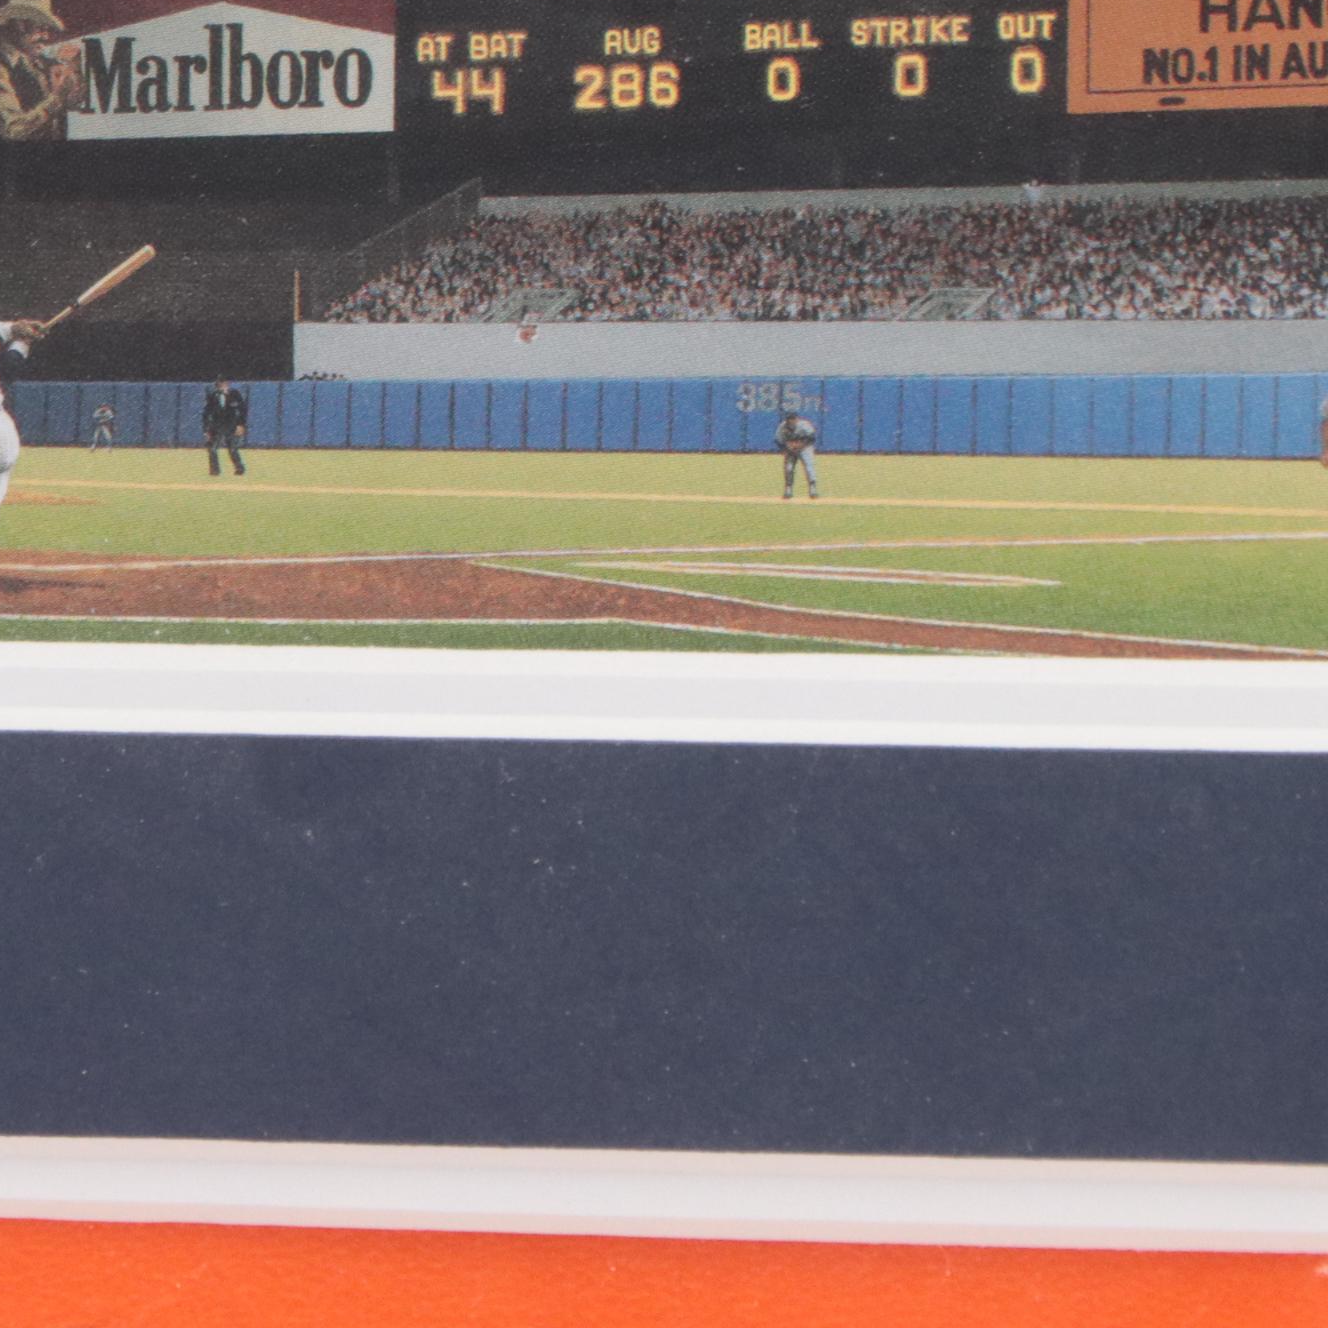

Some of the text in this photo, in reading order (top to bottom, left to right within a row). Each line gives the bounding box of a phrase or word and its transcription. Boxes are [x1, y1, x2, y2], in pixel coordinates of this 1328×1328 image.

[417, 32, 454, 62] AT
[468, 30, 528, 60] BAT
[743, 20, 821, 51] BALL
[851, 15, 971, 47] STRIKE
[998, 13, 1057, 40] OUT
[1233, 44, 1270, 82] IN
[78, 23, 373, 115] Marlboro
[432, 46, 1045, 115] 44 286 0 0 0
